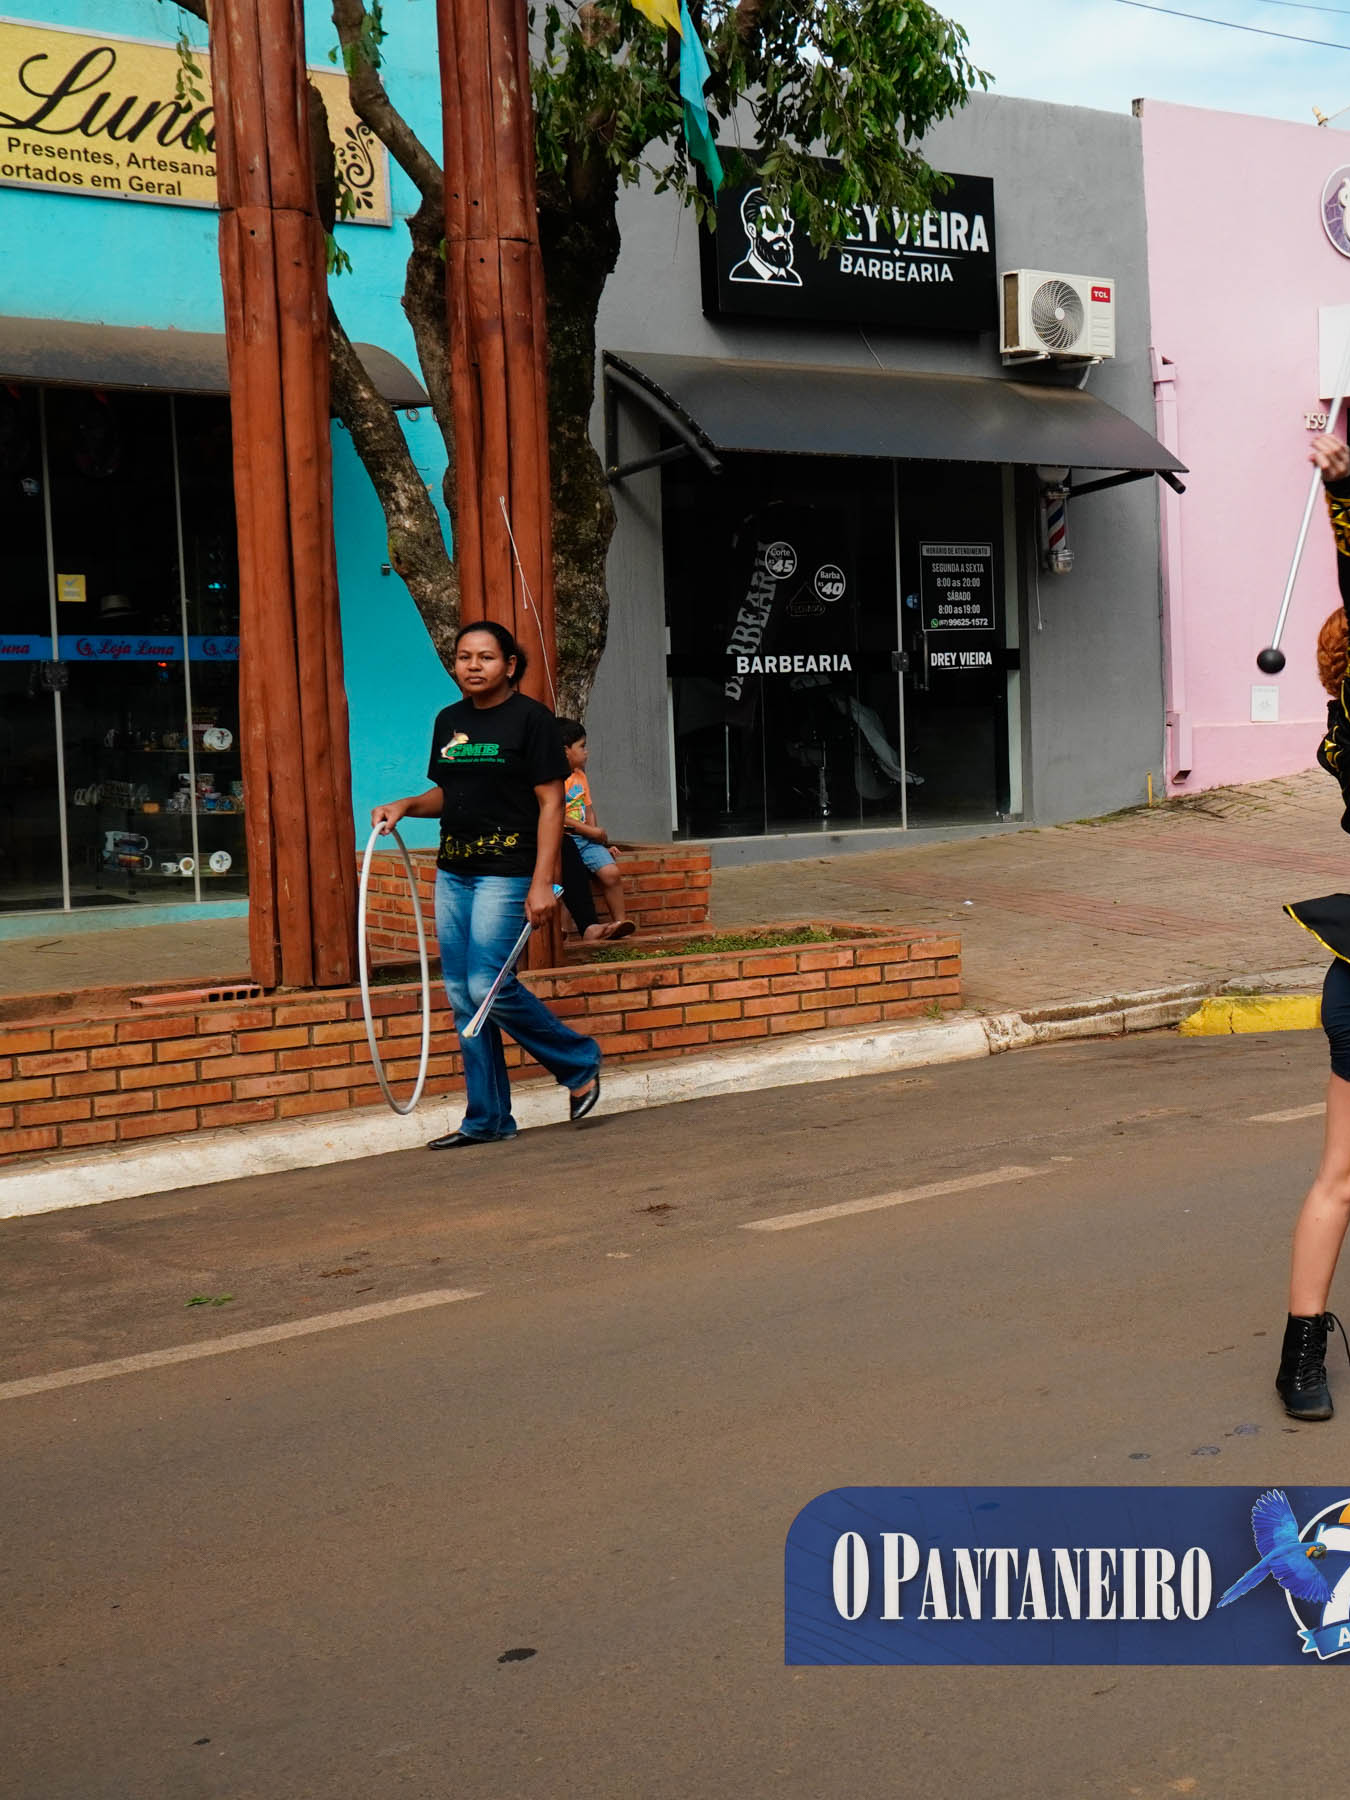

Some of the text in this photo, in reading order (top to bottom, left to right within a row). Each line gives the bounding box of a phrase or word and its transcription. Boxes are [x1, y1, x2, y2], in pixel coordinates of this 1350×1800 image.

[7, 136, 217, 178] Presentes, Artesana
[1, 163, 182, 197] ortados em Geral
[840, 253, 955, 282] BARBEARIA
[1093, 290, 1109, 299] TCL
[1303, 412, 1330, 430] 159
[770, 549, 790, 557] Corte
[772, 559, 794, 573] 45
[932, 563, 984, 573] SEGUNDA A SEXTA
[820, 571, 841, 580] Barba
[936, 577, 951, 587] 8:00
[962, 577, 981, 587] 20:00
[822, 582, 844, 595] 40
[947, 590, 971, 601] SÁBADO
[938, 604, 953, 614] 8:00
[963, 604, 981, 614] 19:00
[736, 654, 853, 674] BARBEARIA
[931, 651, 993, 667] DREY VIEIRA
